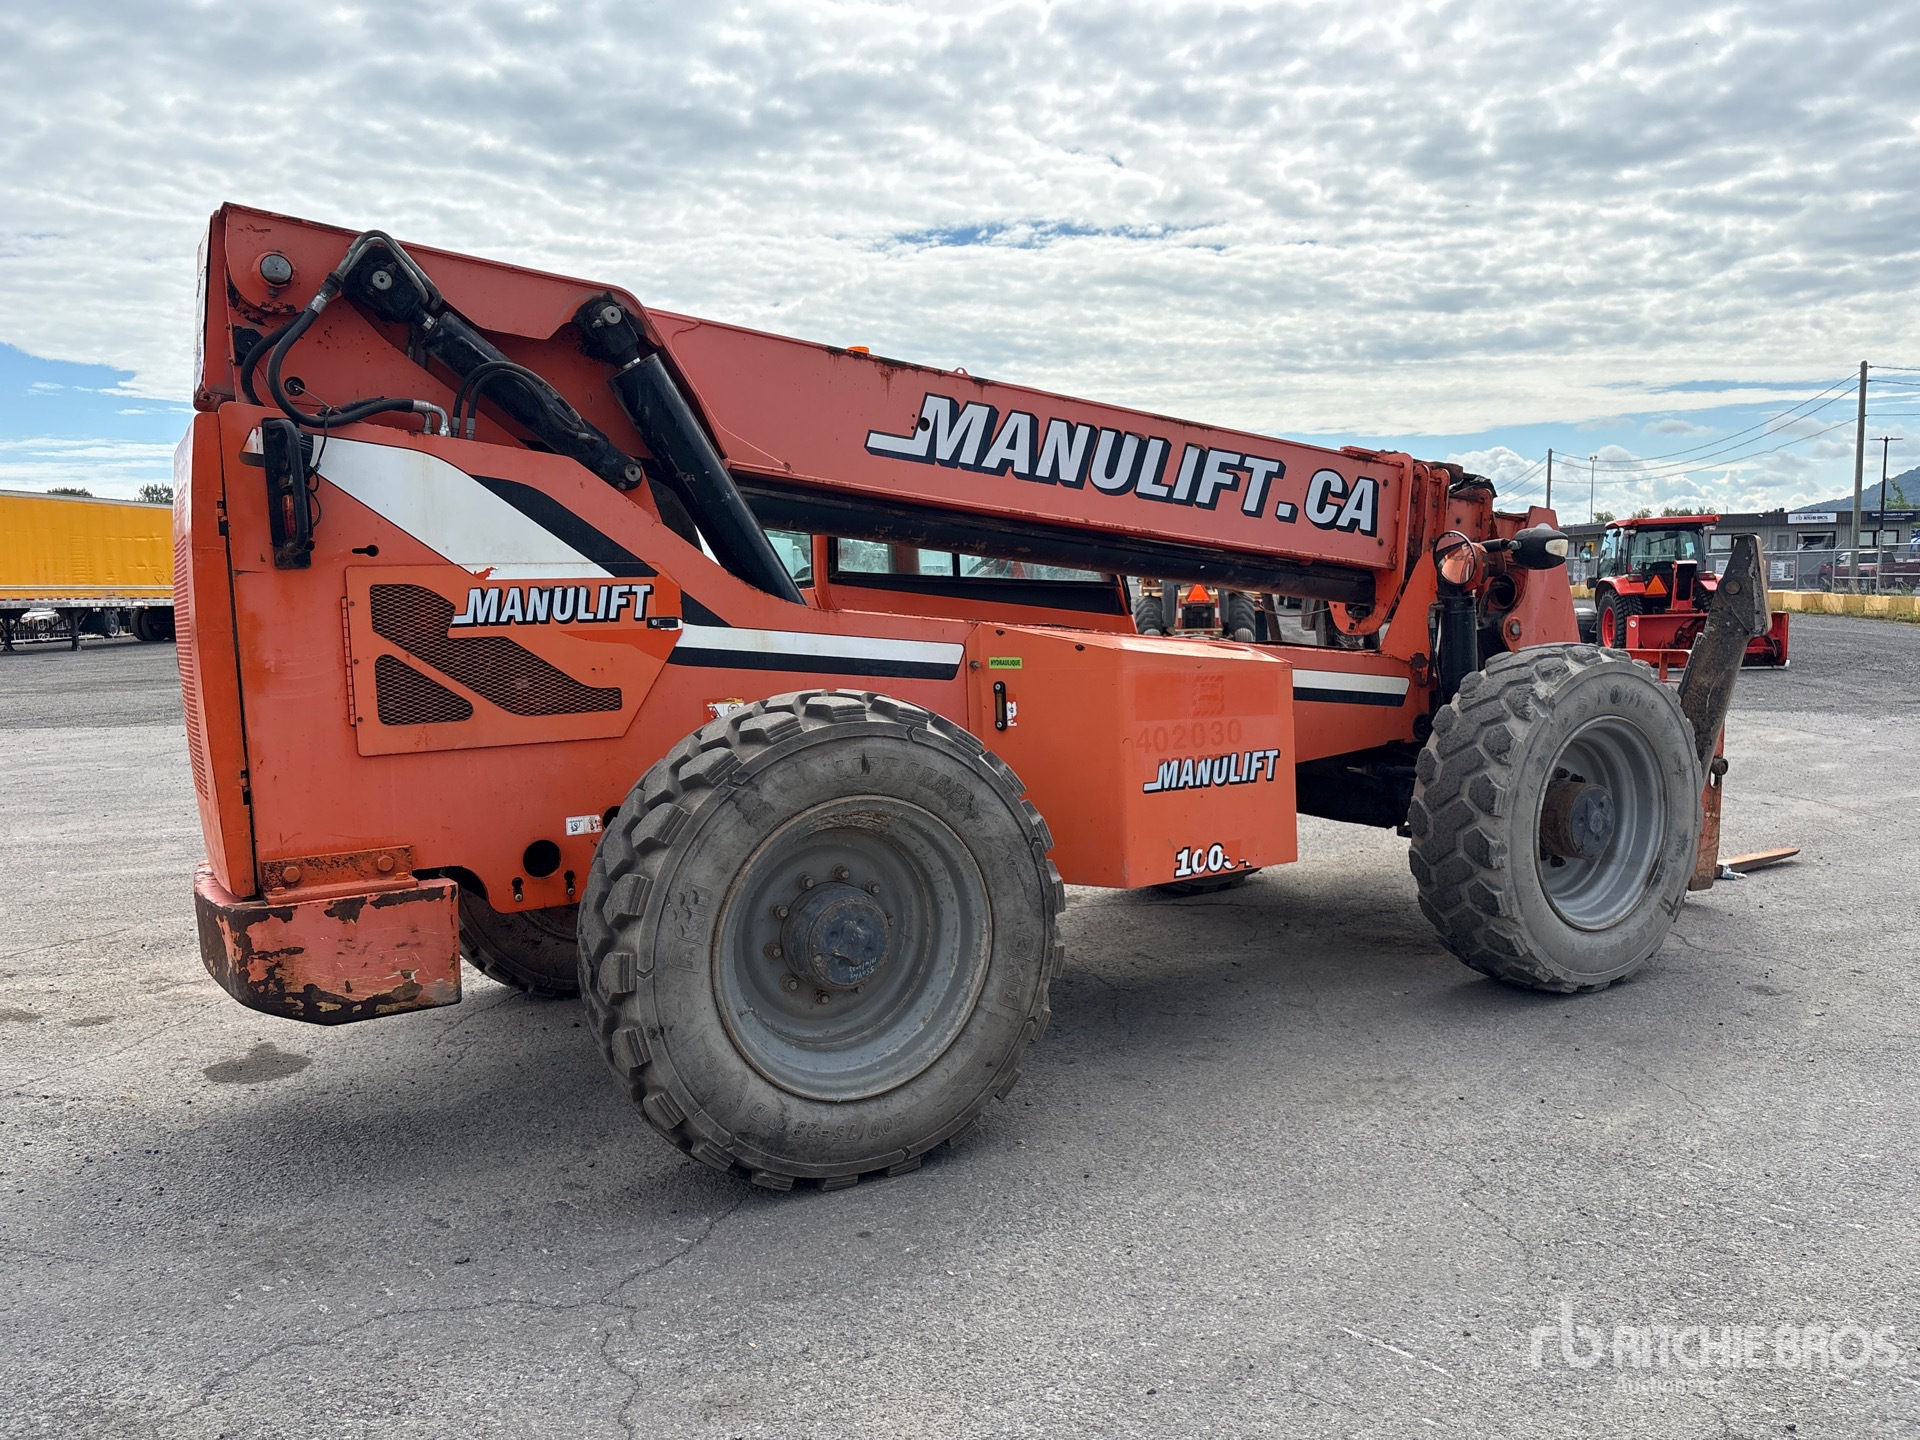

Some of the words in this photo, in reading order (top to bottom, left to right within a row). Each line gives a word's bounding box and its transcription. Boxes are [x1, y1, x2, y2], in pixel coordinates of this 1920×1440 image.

[450, 584, 654, 628] MANULIFT
[990, 659, 1021, 667] HYDRAULIQUE
[1135, 718, 1242, 753] 402030
[1143, 749, 1280, 794] MANULIFT
[1174, 842, 1253, 878] 100
